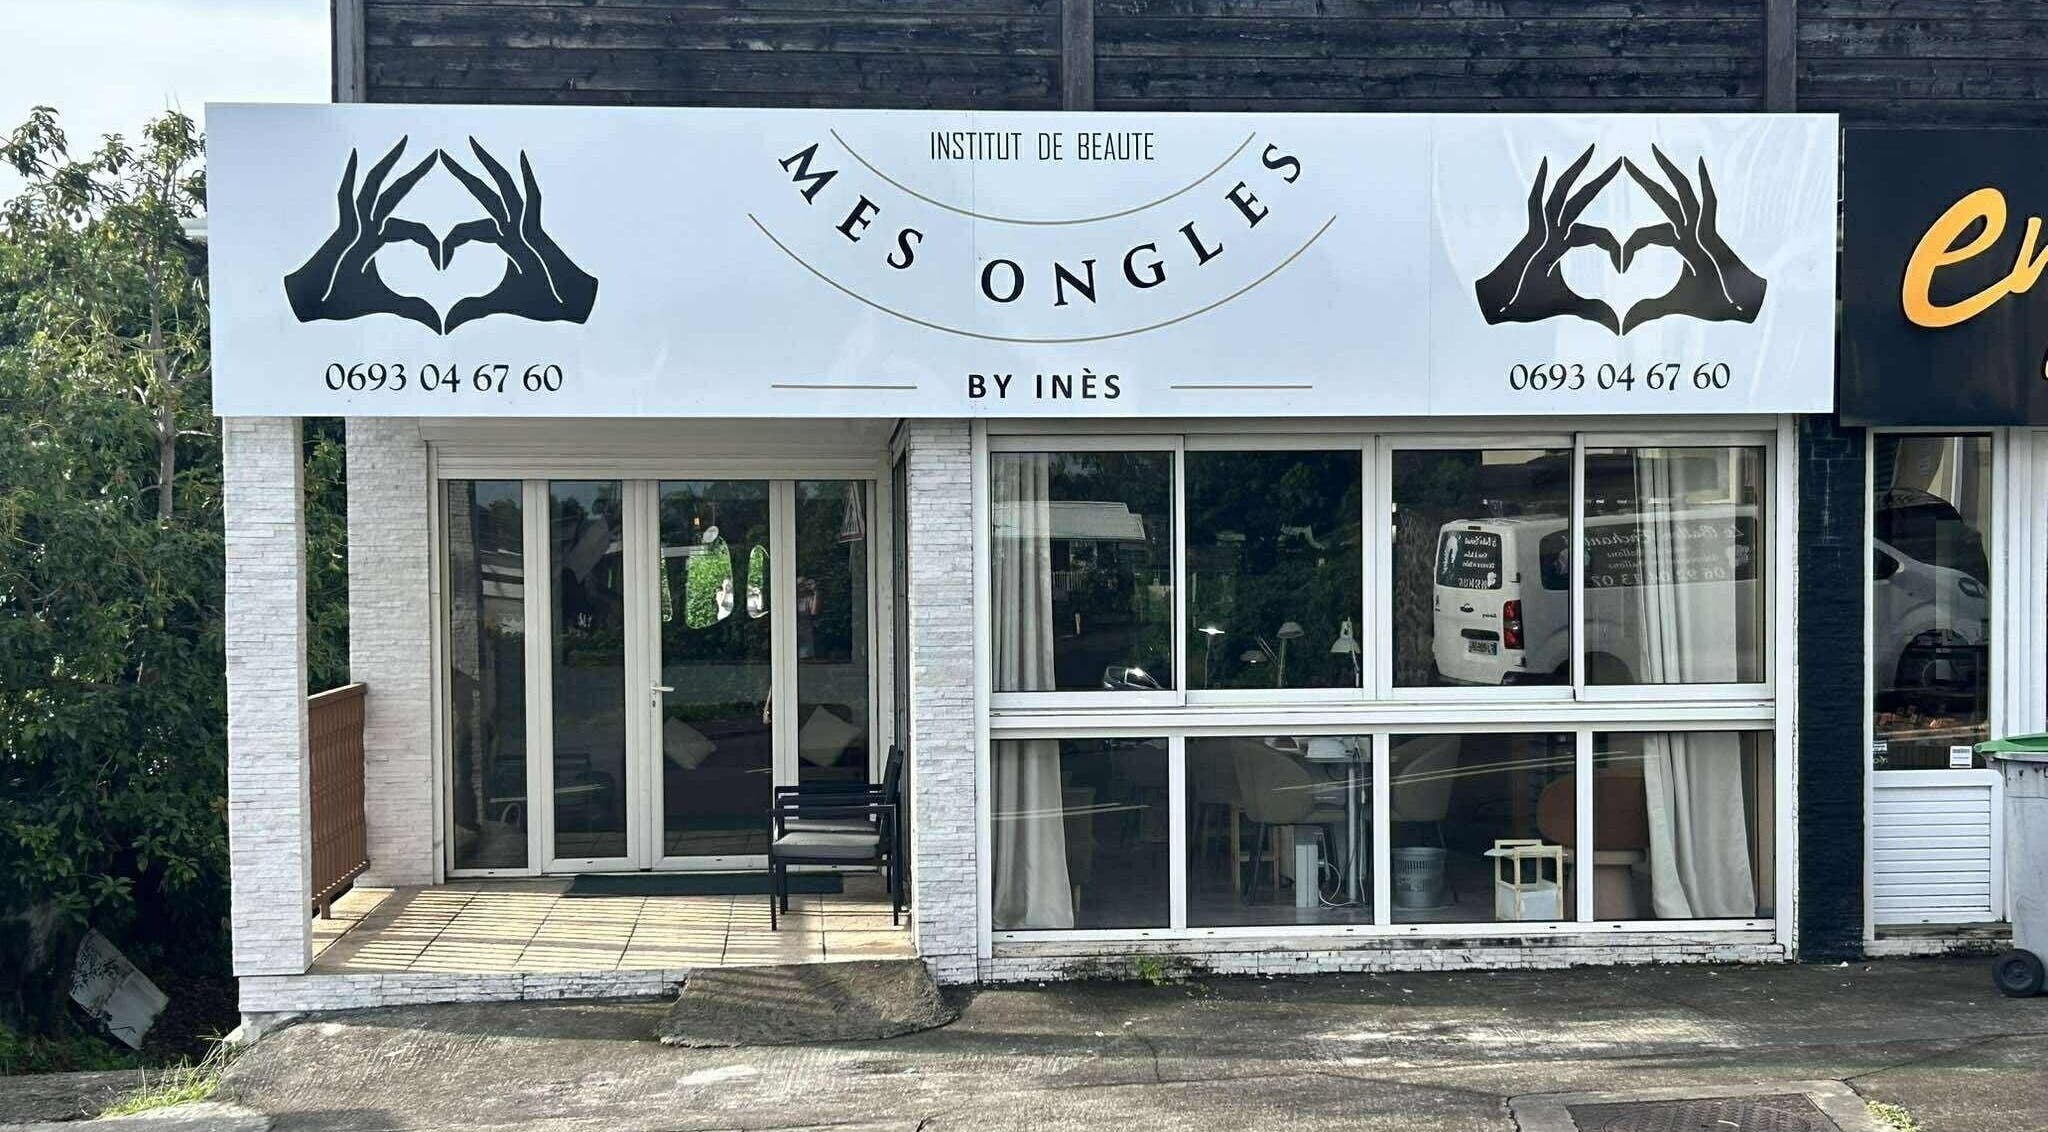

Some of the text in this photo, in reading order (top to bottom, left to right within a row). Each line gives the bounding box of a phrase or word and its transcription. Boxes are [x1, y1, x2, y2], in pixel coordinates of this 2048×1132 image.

[930, 131, 1155, 161] INSTITUT DE BEAUTE
[778, 143, 1302, 307] MES ONGLES
[325, 362, 563, 393] 0693 04 67 60
[968, 367, 1122, 400] BY INÈS
[1509, 362, 1731, 392] 0693 04 67 60
